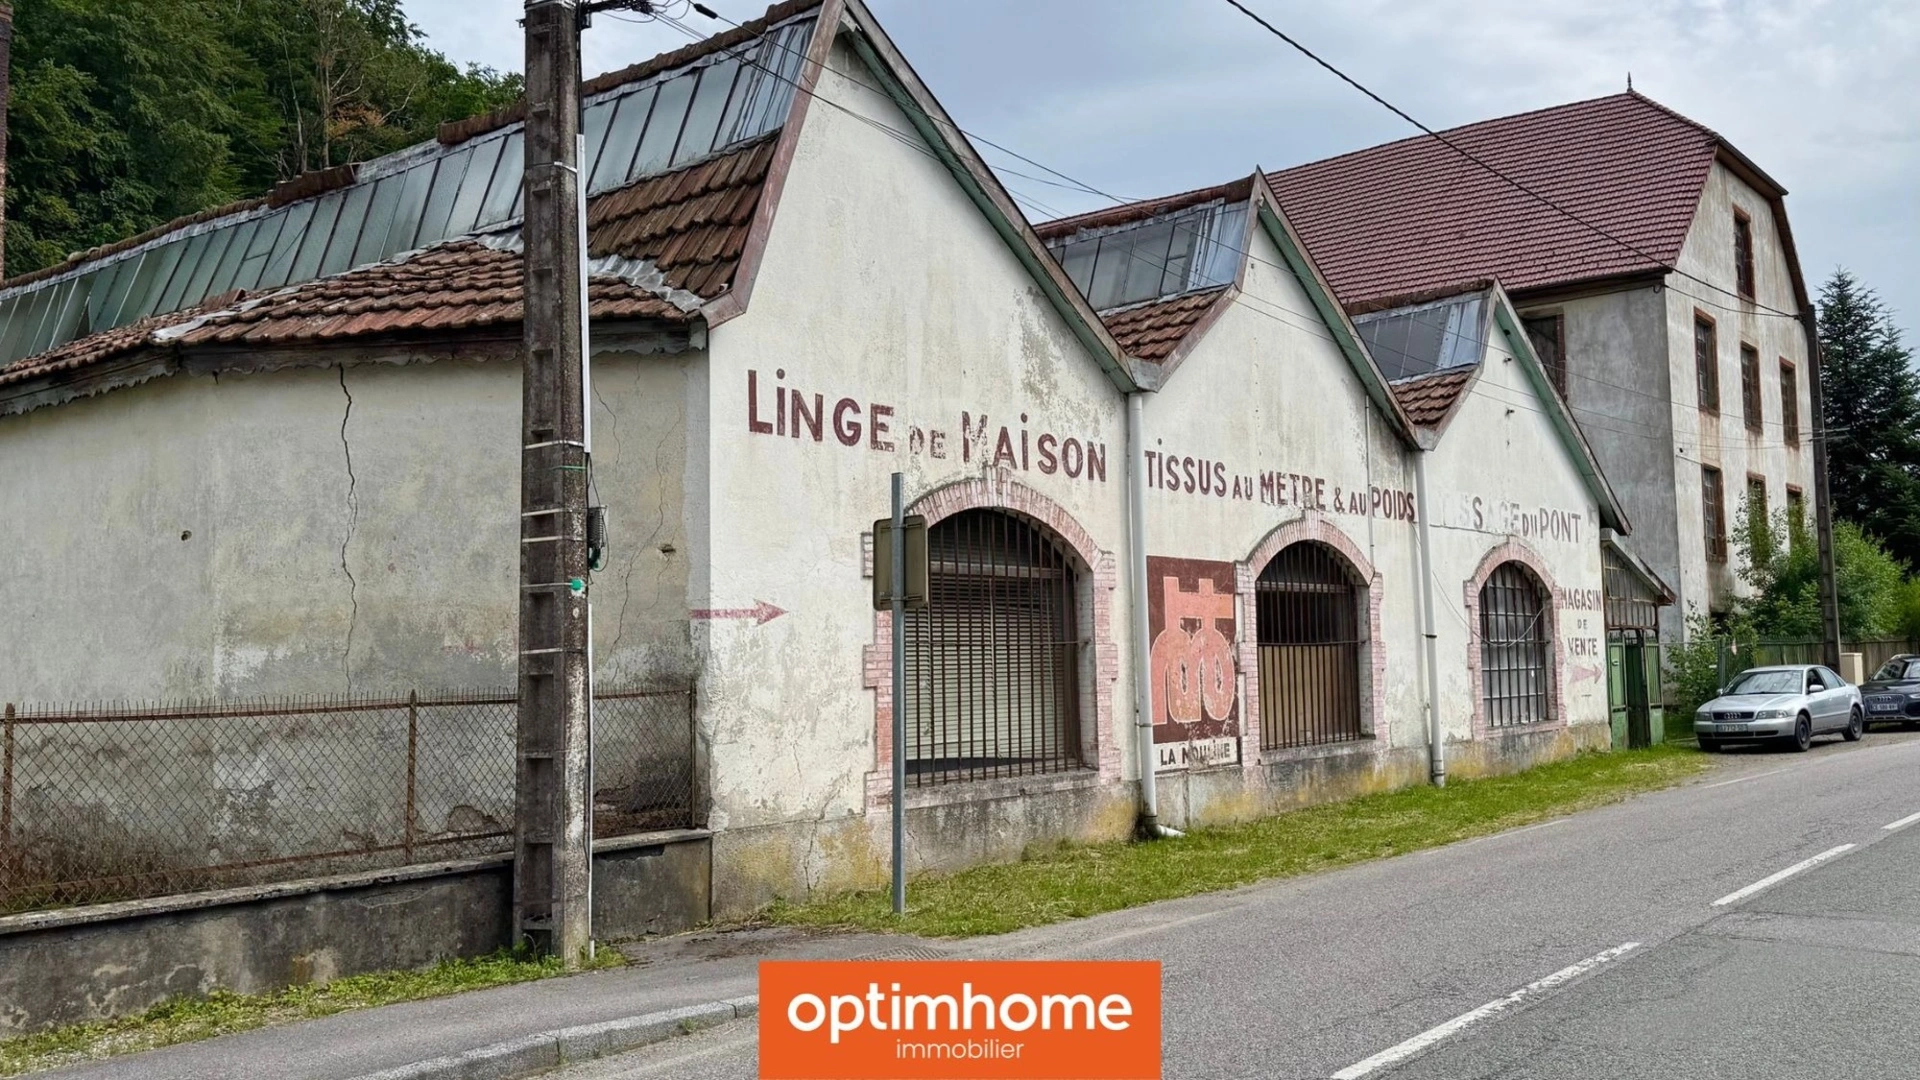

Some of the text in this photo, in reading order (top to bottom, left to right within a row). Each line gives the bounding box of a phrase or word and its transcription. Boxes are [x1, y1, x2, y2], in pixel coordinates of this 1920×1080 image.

[909, 424, 947, 460] DE
[1232, 474, 1254, 501] AU
[1259, 470, 1326, 511] METRE
[1333, 486, 1345, 512] &
[1349, 491, 1367, 516] AU
[1371, 486, 1416, 523] POIDS
[1539, 507, 1582, 544] PONT
[1561, 587, 1602, 612] MAGASIN
[1577, 618, 1588, 630] DE
[1567, 637, 1598, 656] VENTE
[1160, 748, 1176, 766] LA
